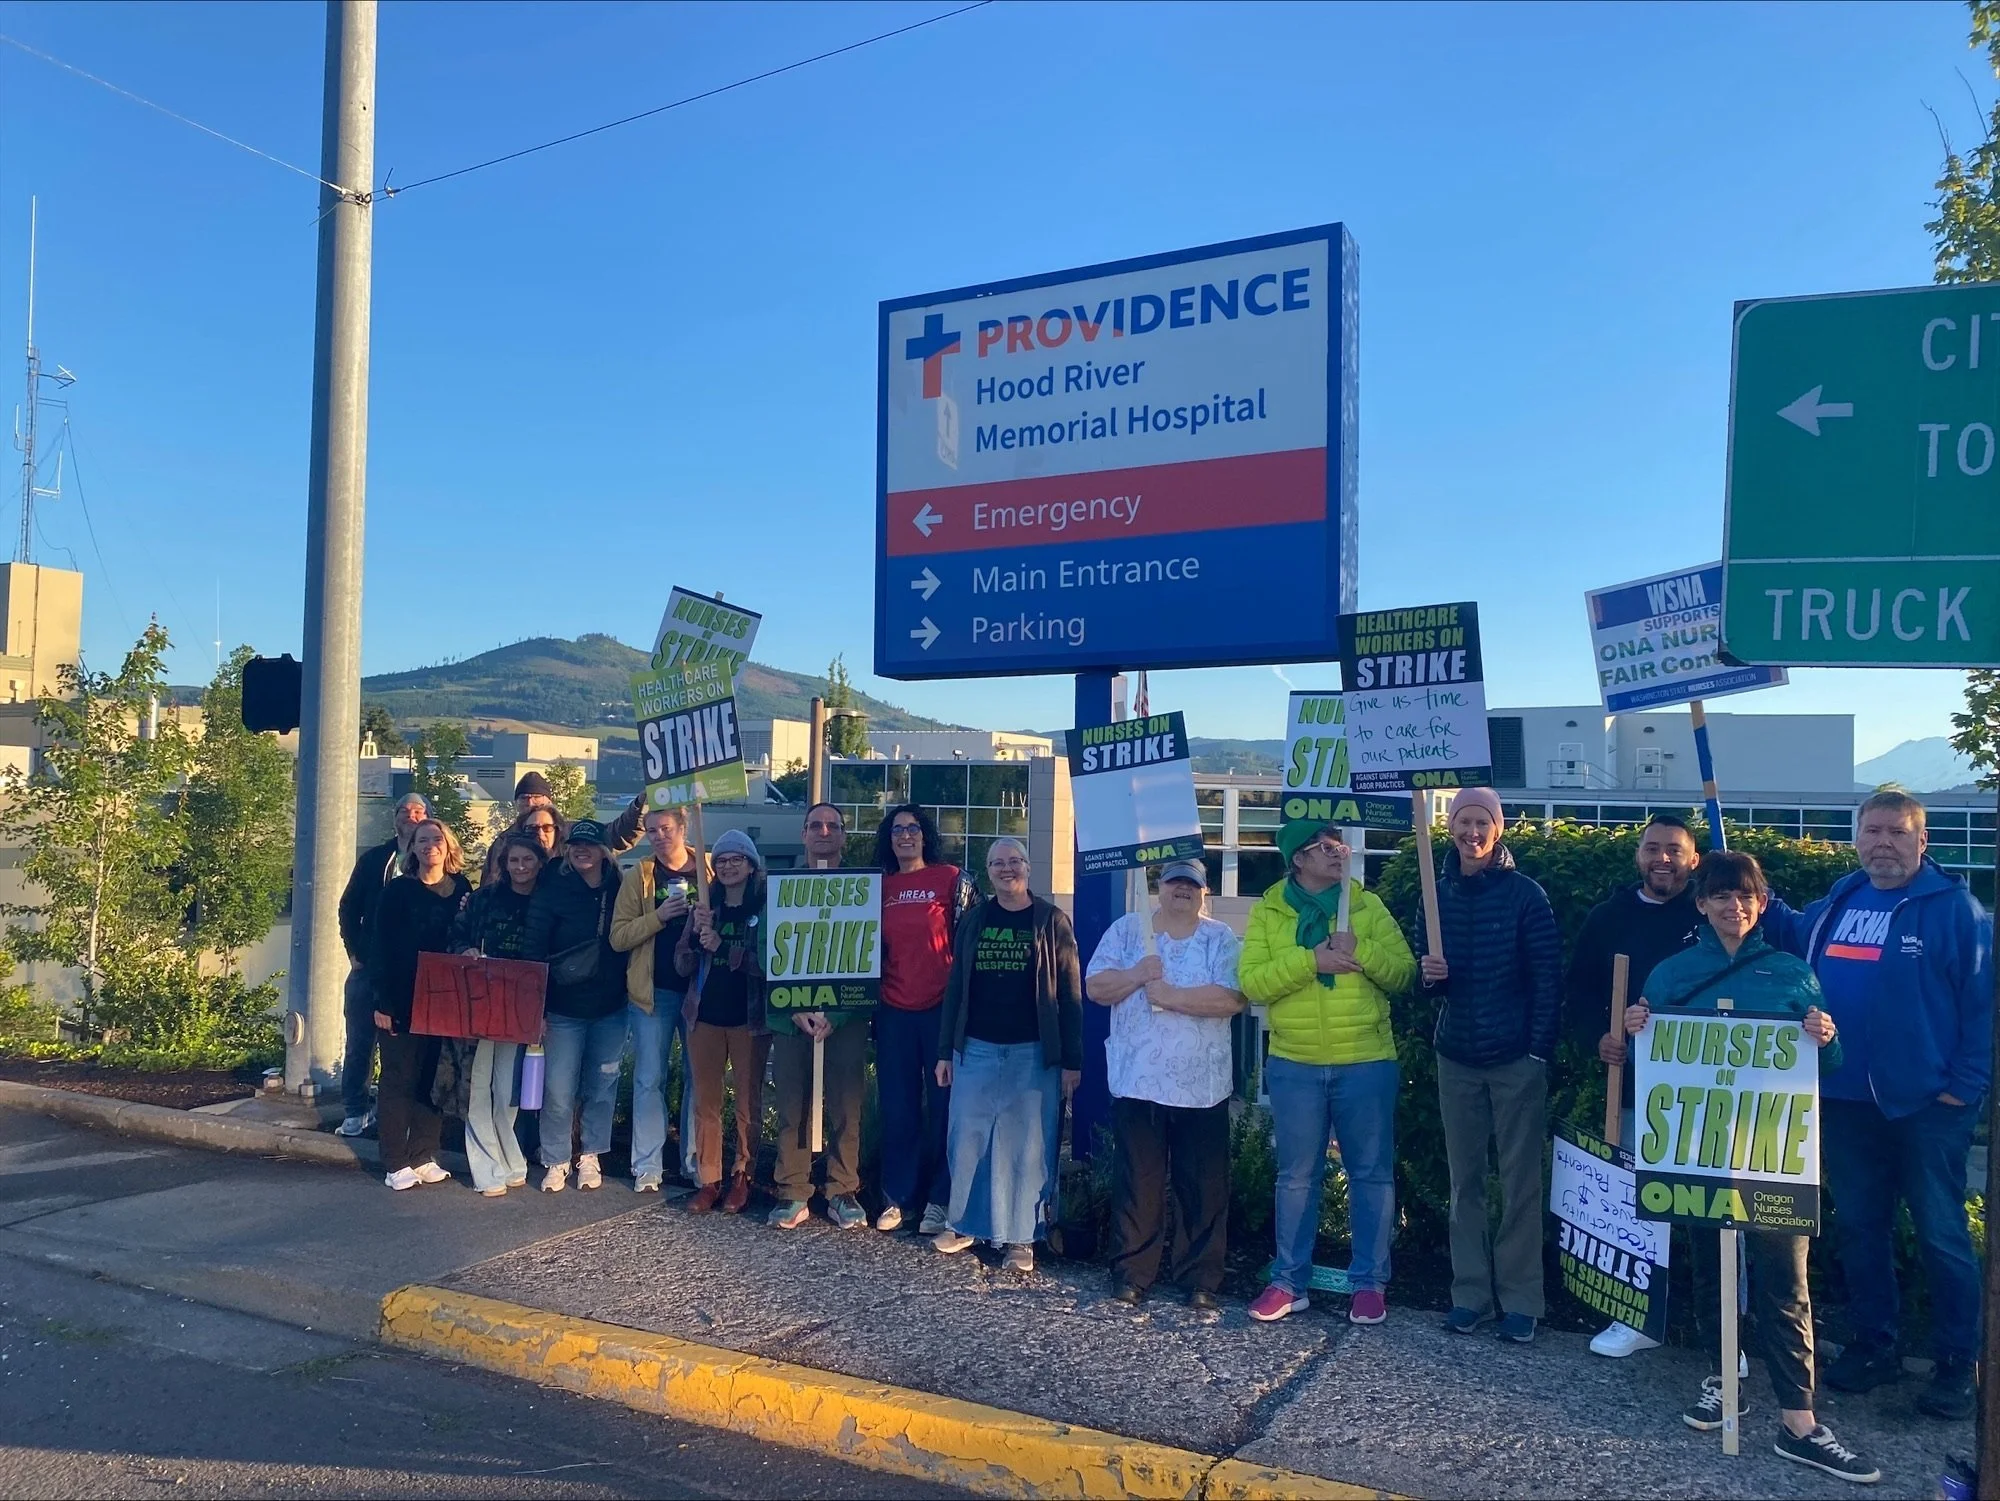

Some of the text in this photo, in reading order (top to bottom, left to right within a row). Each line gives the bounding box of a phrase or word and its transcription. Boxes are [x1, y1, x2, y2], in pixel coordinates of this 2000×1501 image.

[978, 267, 1310, 358] PROVIDENCE
[1922, 313, 2000, 371] CI
[976, 360, 1145, 404] Hood River
[976, 388, 1266, 453] Memorial Hospital
[973, 494, 1141, 531] Emergency
[973, 556, 1199, 594] Main Entrance
[1646, 573, 1706, 616] WSNA
[672, 596, 752, 639] NURSES
[972, 613, 1085, 645] Parking
[1356, 606, 1459, 634] HEALTHCARE
[1644, 604, 1720, 632] SUPPORTS
[1765, 586, 1972, 642] TRUCK
[650, 630, 747, 678] STRE
[1355, 627, 1464, 656] WORKERS ON
[1600, 624, 1719, 662] ONA NUR
[637, 663, 720, 698] HEALTHCARE
[1356, 650, 1467, 688] STRIKE
[1600, 648, 1720, 687] FAIR Cont
[640, 681, 725, 716] WORKERS ON
[1349, 692, 1385, 715] Give
[1392, 697, 1412, 710] us
[1687, 681, 1715, 694] NURSES
[643, 700, 738, 780] STRIKE
[1082, 714, 1170, 746] NURSES ON
[1354, 726, 1373, 744] to
[1082, 733, 1175, 772] STRIKE
[1287, 736, 1350, 788] STR
[1355, 771, 1399, 782] AGAINST UNFAIR
[1356, 779, 1406, 791] LABOR PRACTICES
[1412, 771, 1460, 788] ONA
[654, 781, 709, 805] ONA
[1365, 801, 1395, 812] Oregon
[1284, 798, 1361, 822] ONA
[1365, 816, 1409, 826] Association
[1084, 850, 1122, 862] AGAINST UNFAIR
[1085, 858, 1128, 871] LABOR PRACTICES
[1135, 844, 1177, 862] ONA
[777, 876, 870, 908] NURSES
[899, 890, 928, 900] HREA
[818, 908, 831, 919] ON
[1833, 909, 1893, 945] WSNA
[770, 919, 878, 977] STRIKE
[981, 927, 1014, 941] NA
[975, 961, 1027, 971] RESPECT
[977, 950, 1024, 960] RETAIN
[770, 985, 838, 1008] ONA
[840, 984, 866, 994] Oregon
[1650, 1019, 1801, 1070] NURSES
[1716, 1068, 1735, 1086] ON
[1640, 1083, 1813, 1175] STRIKE
[1575, 1131, 1612, 1160] ONA
[1641, 1182, 1749, 1222] ONA
[1753, 1191, 1794, 1205] Oregon
[1753, 1203, 1792, 1215] Nurses
[1753, 1213, 1815, 1227] Association
[1559, 1222, 1651, 1290] STRIKE
[1563, 1274, 1647, 1331] HEALTHCARE
[1578, 1262, 1649, 1312] WORKERS
